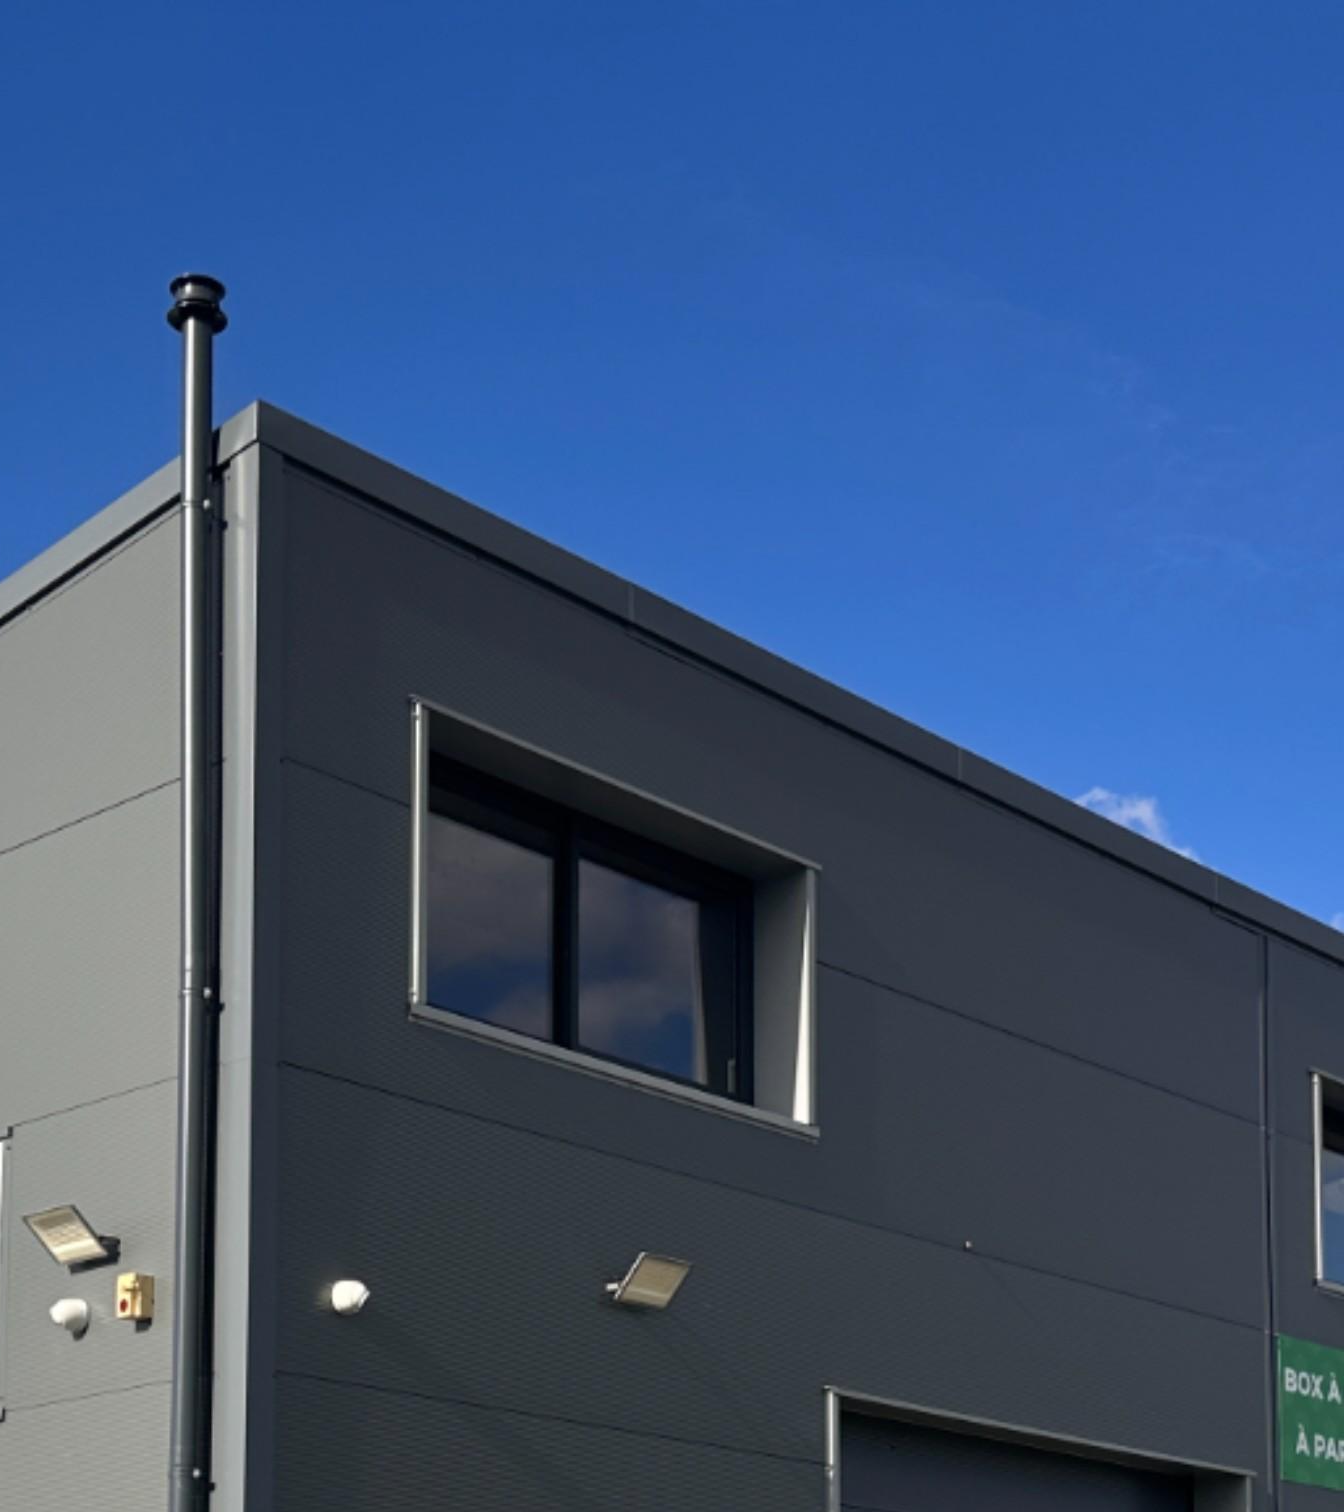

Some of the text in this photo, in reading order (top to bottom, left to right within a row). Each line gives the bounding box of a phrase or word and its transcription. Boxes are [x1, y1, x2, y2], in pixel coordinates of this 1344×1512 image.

[1284, 1367, 1323, 1399] BOX
[1327, 1372, 1341, 1405] À
[1296, 1424, 1310, 1456] À
